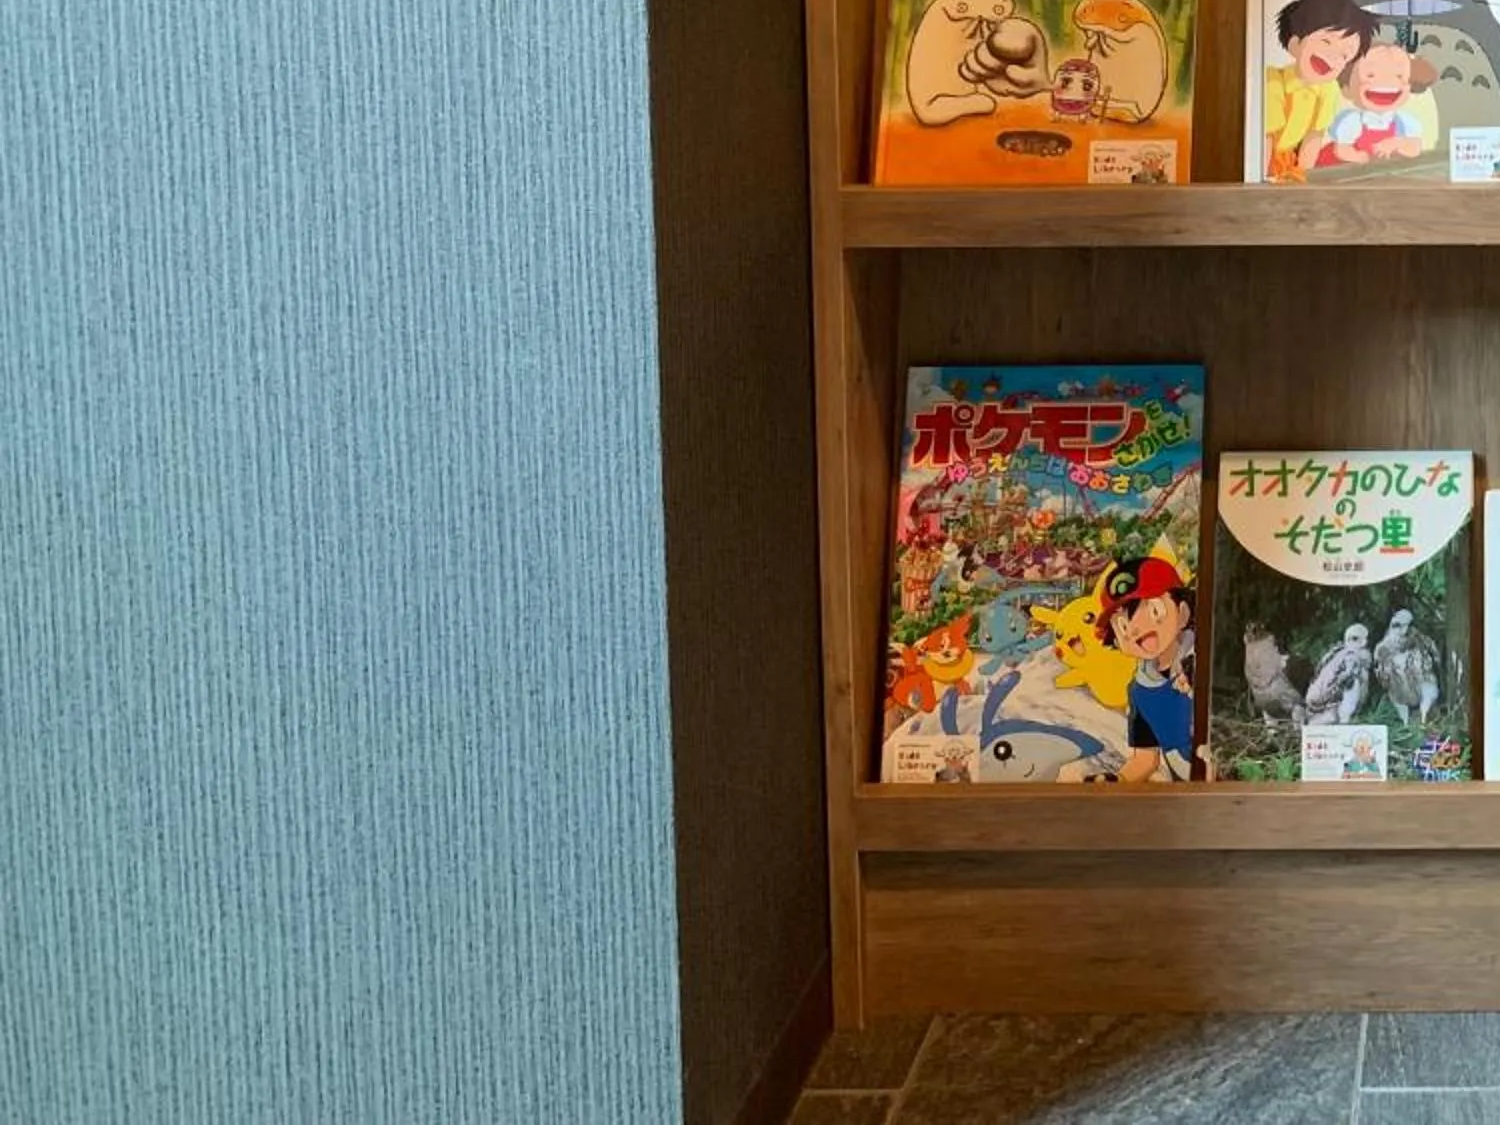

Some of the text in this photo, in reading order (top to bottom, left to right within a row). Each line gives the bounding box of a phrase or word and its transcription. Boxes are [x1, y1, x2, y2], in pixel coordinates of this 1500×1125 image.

[911, 402, 1148, 467] ポケモン
[1229, 458, 1463, 497] オオタカのひな
[1335, 498, 1357, 520] の
[1274, 515, 1415, 555] そだつ里
